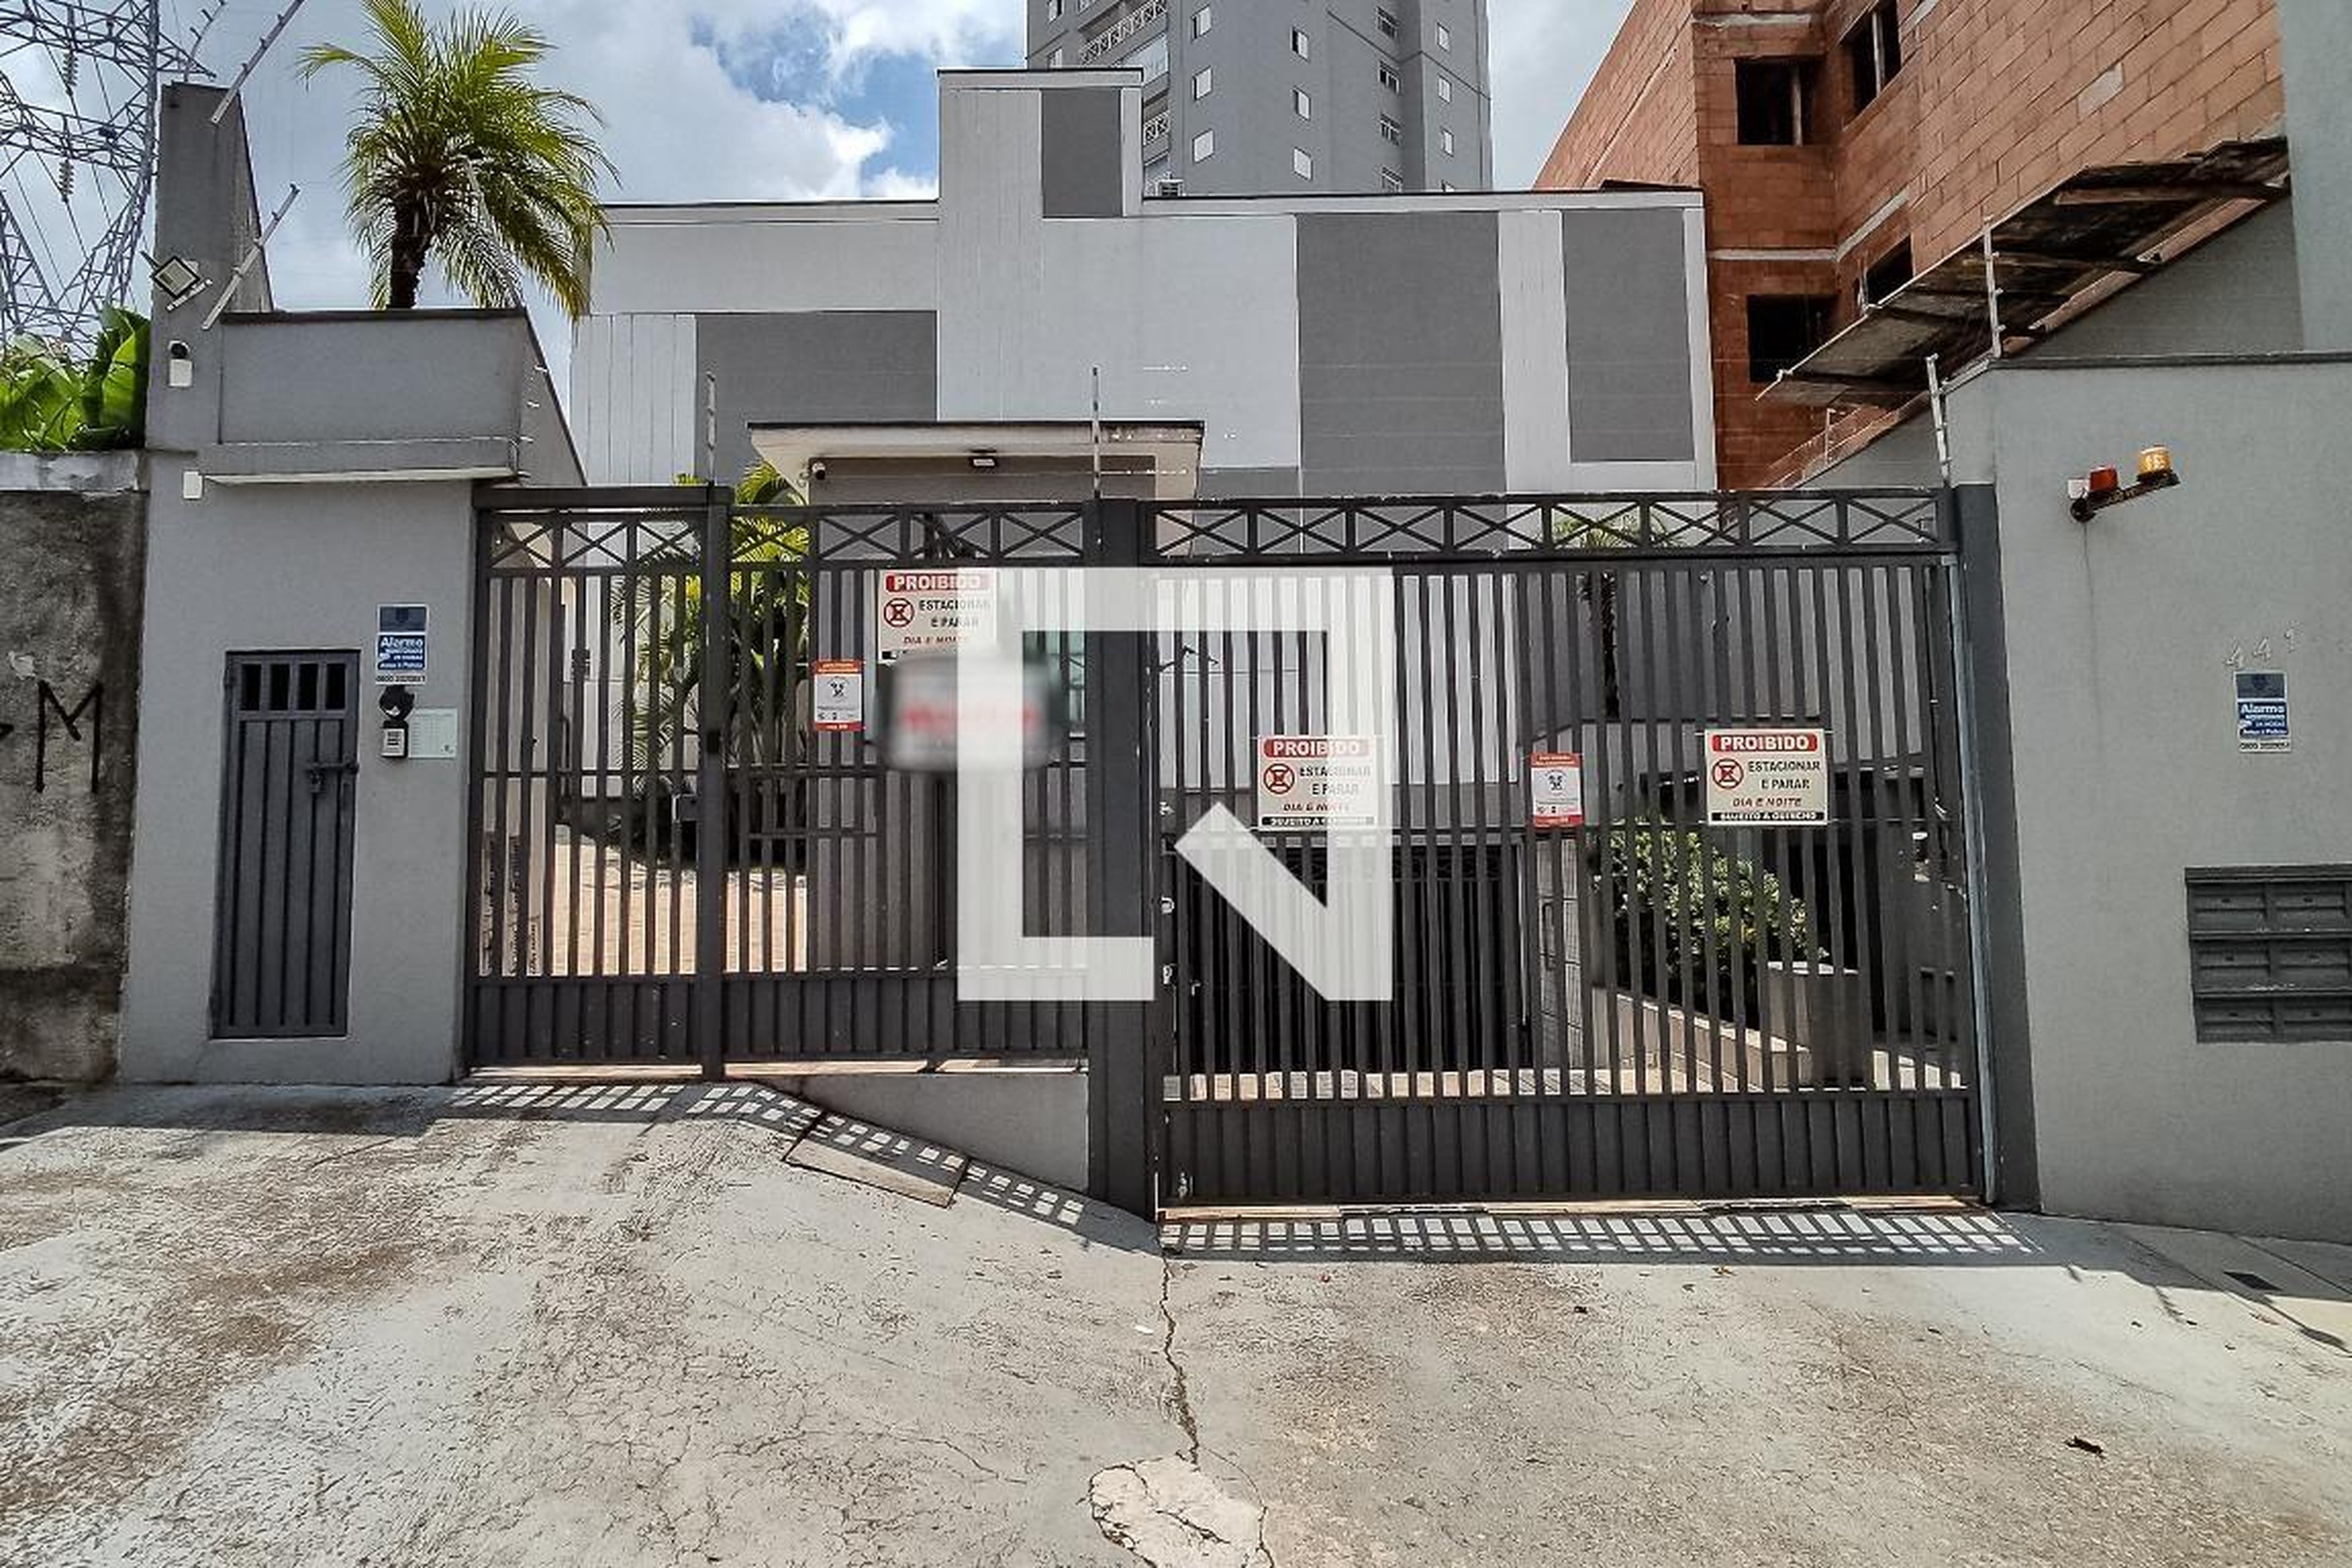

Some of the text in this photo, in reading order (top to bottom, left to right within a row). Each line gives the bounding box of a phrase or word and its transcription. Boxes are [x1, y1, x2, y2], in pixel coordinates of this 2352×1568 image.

[894, 575, 981, 590] PROIBIDO
[930, 617, 938, 627] E
[1273, 740, 1360, 756] PROIBIDO
[1721, 736, 1809, 750] PROIBIDO
[1748, 760, 1820, 772] ESTACIONAR
[1312, 783, 1320, 796] E
[1761, 778, 1811, 790] E PARAR
[1283, 803, 1303, 812] DIA
[1733, 797, 1803, 807] DIA E NOITE
